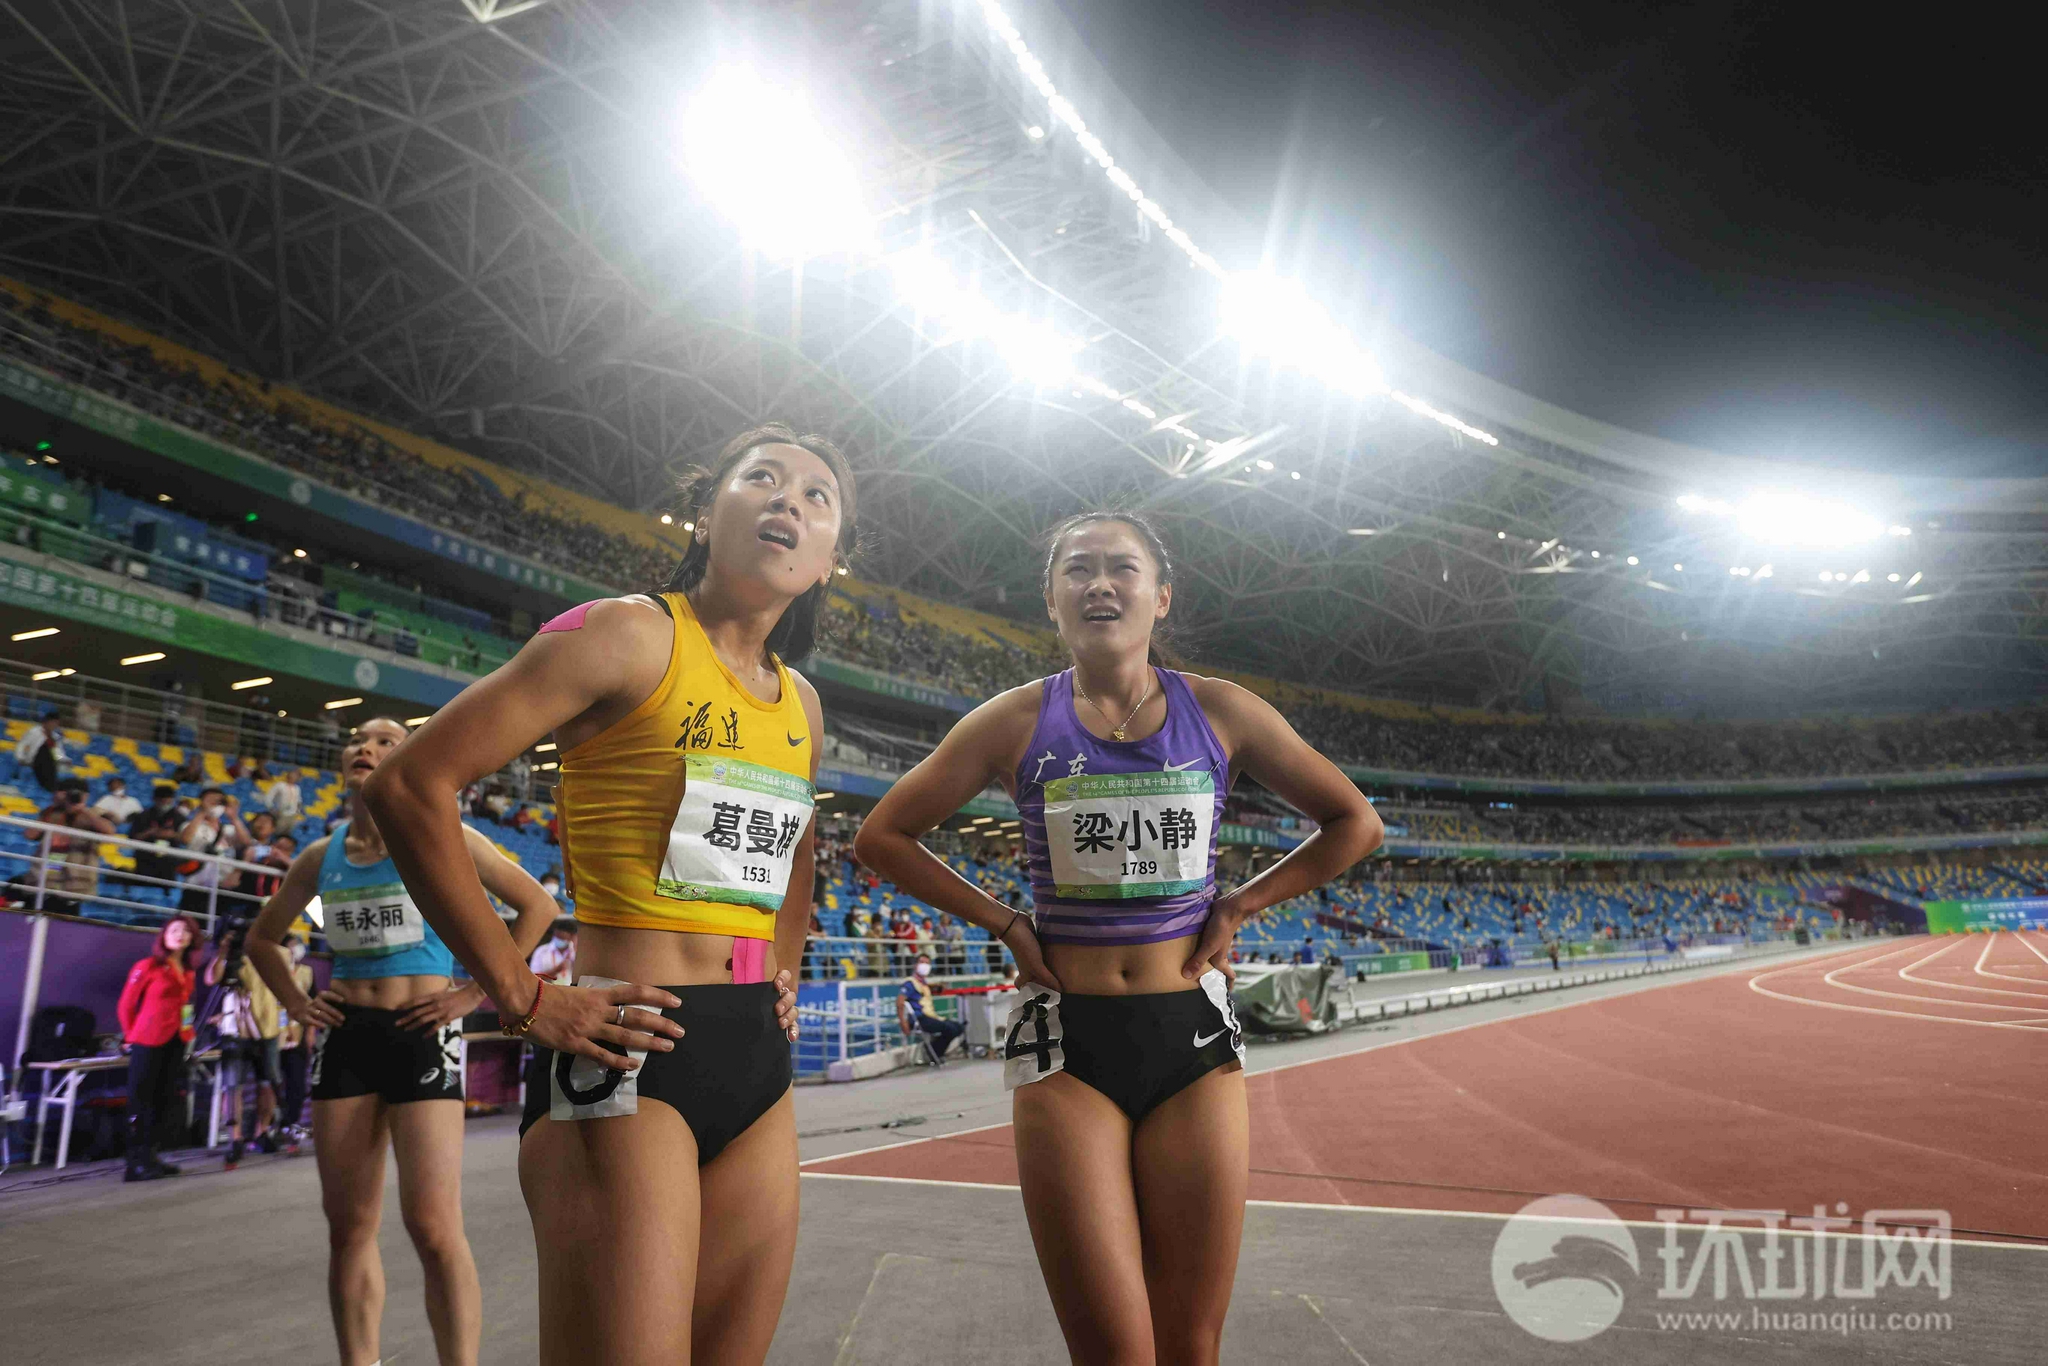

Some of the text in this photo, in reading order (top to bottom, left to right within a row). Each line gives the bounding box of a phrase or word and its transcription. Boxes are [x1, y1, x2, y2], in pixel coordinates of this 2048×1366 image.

[1031, 751, 1088, 783] 广东
[703, 801, 800, 858] 葛曼棋
[1073, 808, 1197, 854] 梁小静
[742, 866, 771, 883] 1531
[1121, 861, 1157, 876] 1789
[335, 904, 404, 932] 韦永丽
[1006, 993, 1061, 1073] 4
